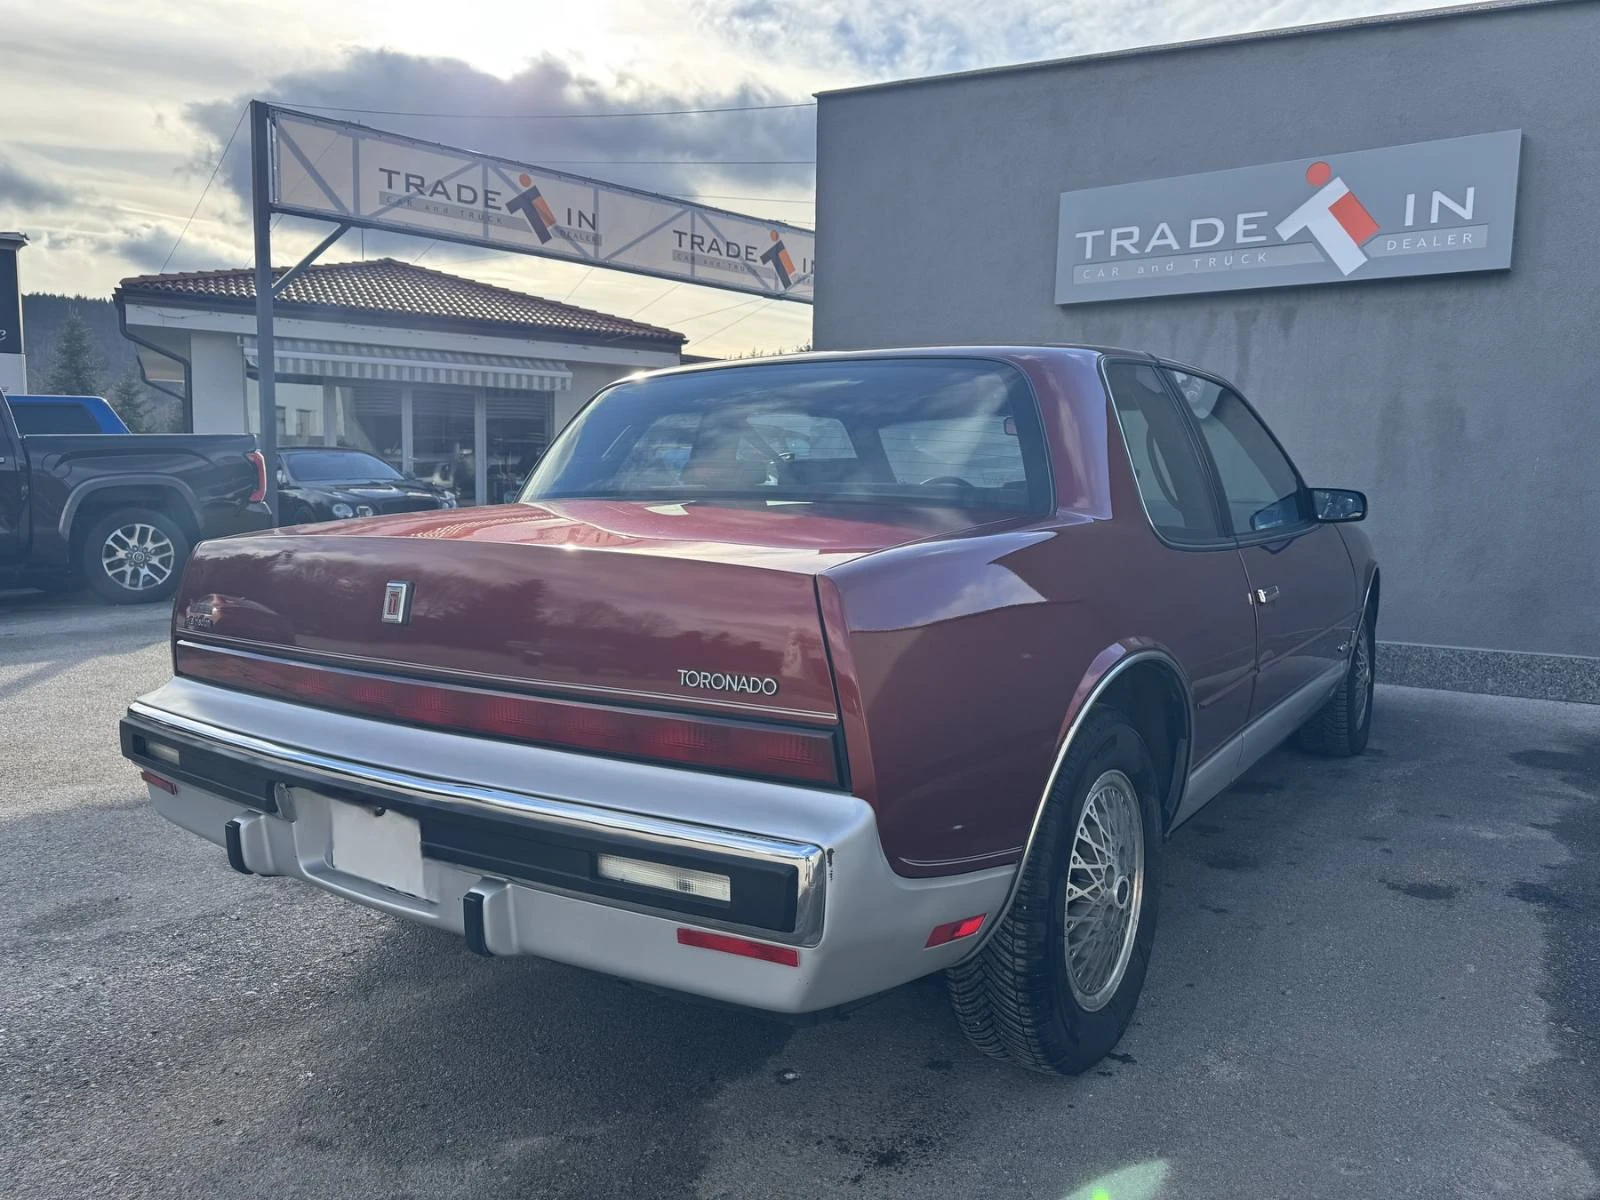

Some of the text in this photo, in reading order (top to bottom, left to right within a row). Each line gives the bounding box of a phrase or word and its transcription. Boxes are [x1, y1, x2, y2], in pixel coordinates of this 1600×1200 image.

[379, 168, 502, 211] TRADE
[566, 207, 597, 232] IN
[425, 204, 450, 216] and
[460, 210, 502, 224] TRUCK
[1075, 211, 1268, 260] TRADE
[1404, 186, 1475, 226] IN
[673, 230, 758, 262] TRADE
[1082, 232, 1473, 280] CAR and TRUCK DEALER
[677, 669, 777, 695] TORONADO
